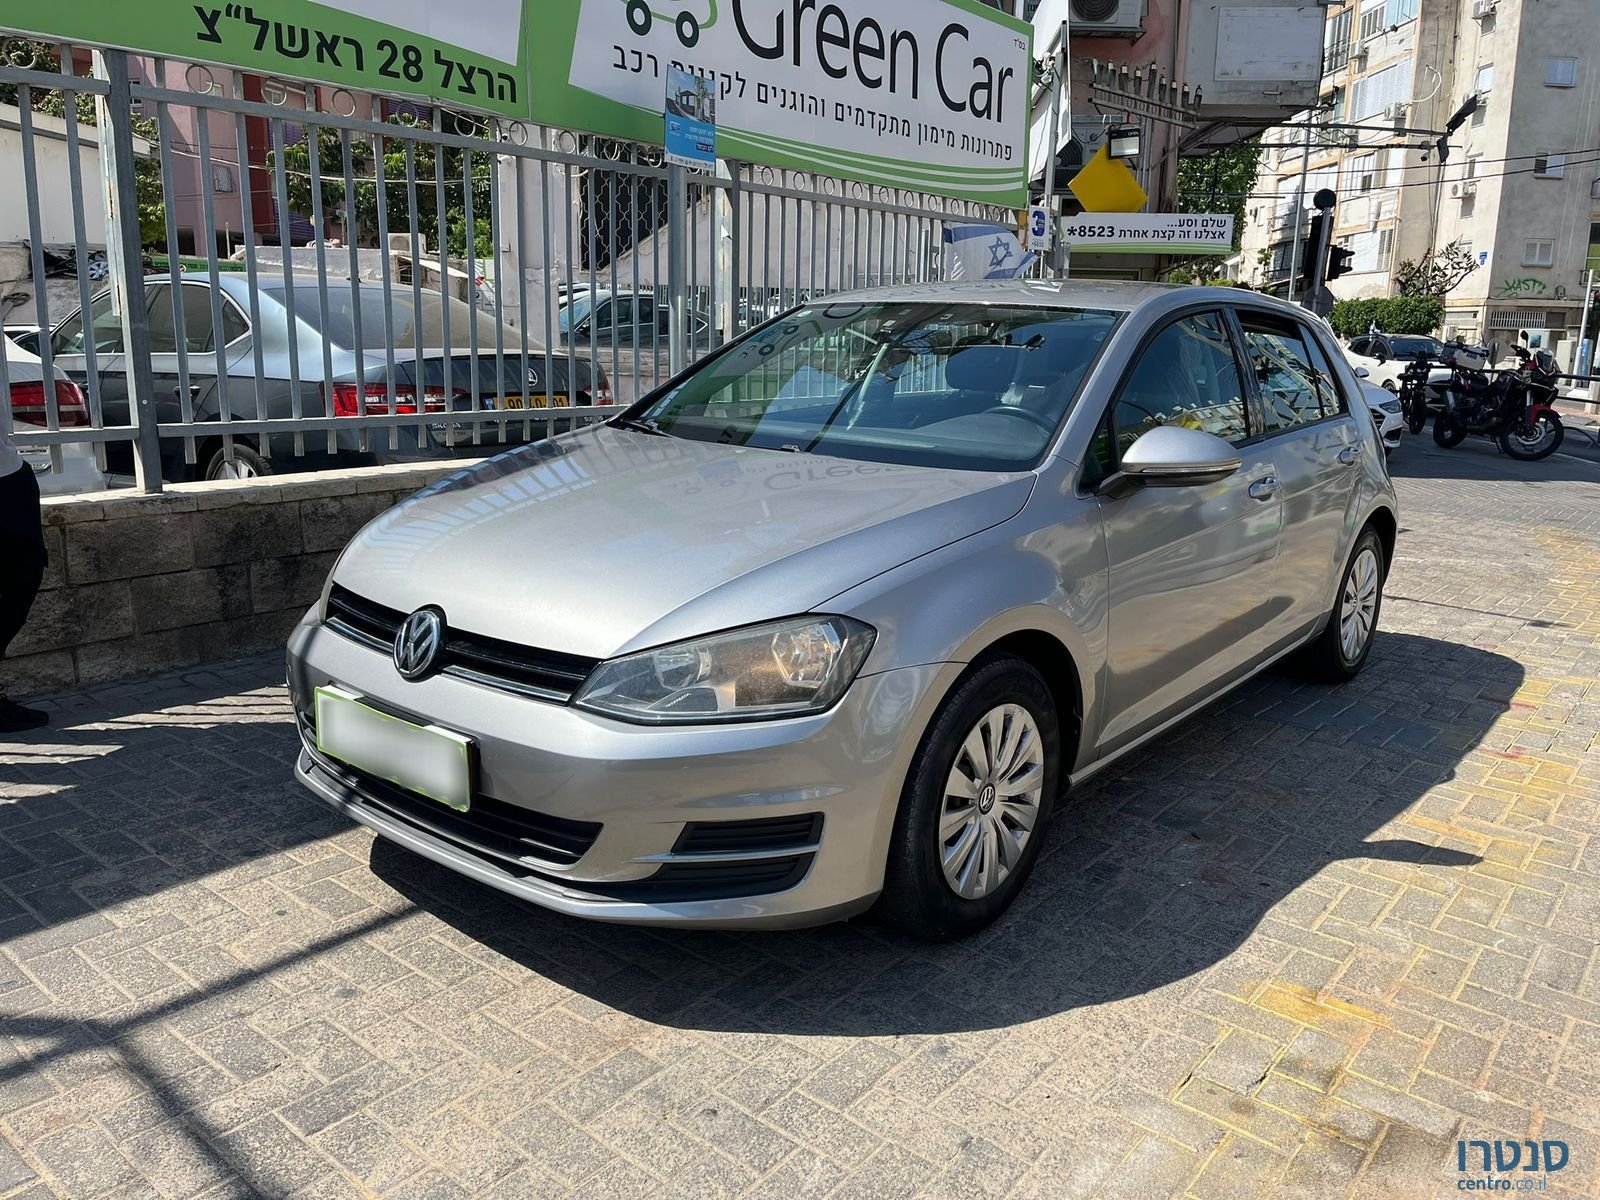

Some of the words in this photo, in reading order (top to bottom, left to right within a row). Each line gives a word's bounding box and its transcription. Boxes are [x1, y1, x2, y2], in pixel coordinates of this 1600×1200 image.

[376, 39, 424, 83] 28
[613, 45, 659, 78] רכב
[935, 22, 1014, 124] Car
[433, 48, 517, 104] הרצל
[757, 82, 826, 118] והוגנים
[835, 102, 911, 138] מתקדמים
[917, 123, 955, 148] מימון
[961, 134, 1012, 161] פתרונות
[1118, 229, 1149, 238] אחרת
[1152, 229, 1175, 241] קצת
[1179, 230, 1190, 239] זה
[1195, 228, 1226, 239] אצלנו
[1201, 217, 1226, 228] שלם
